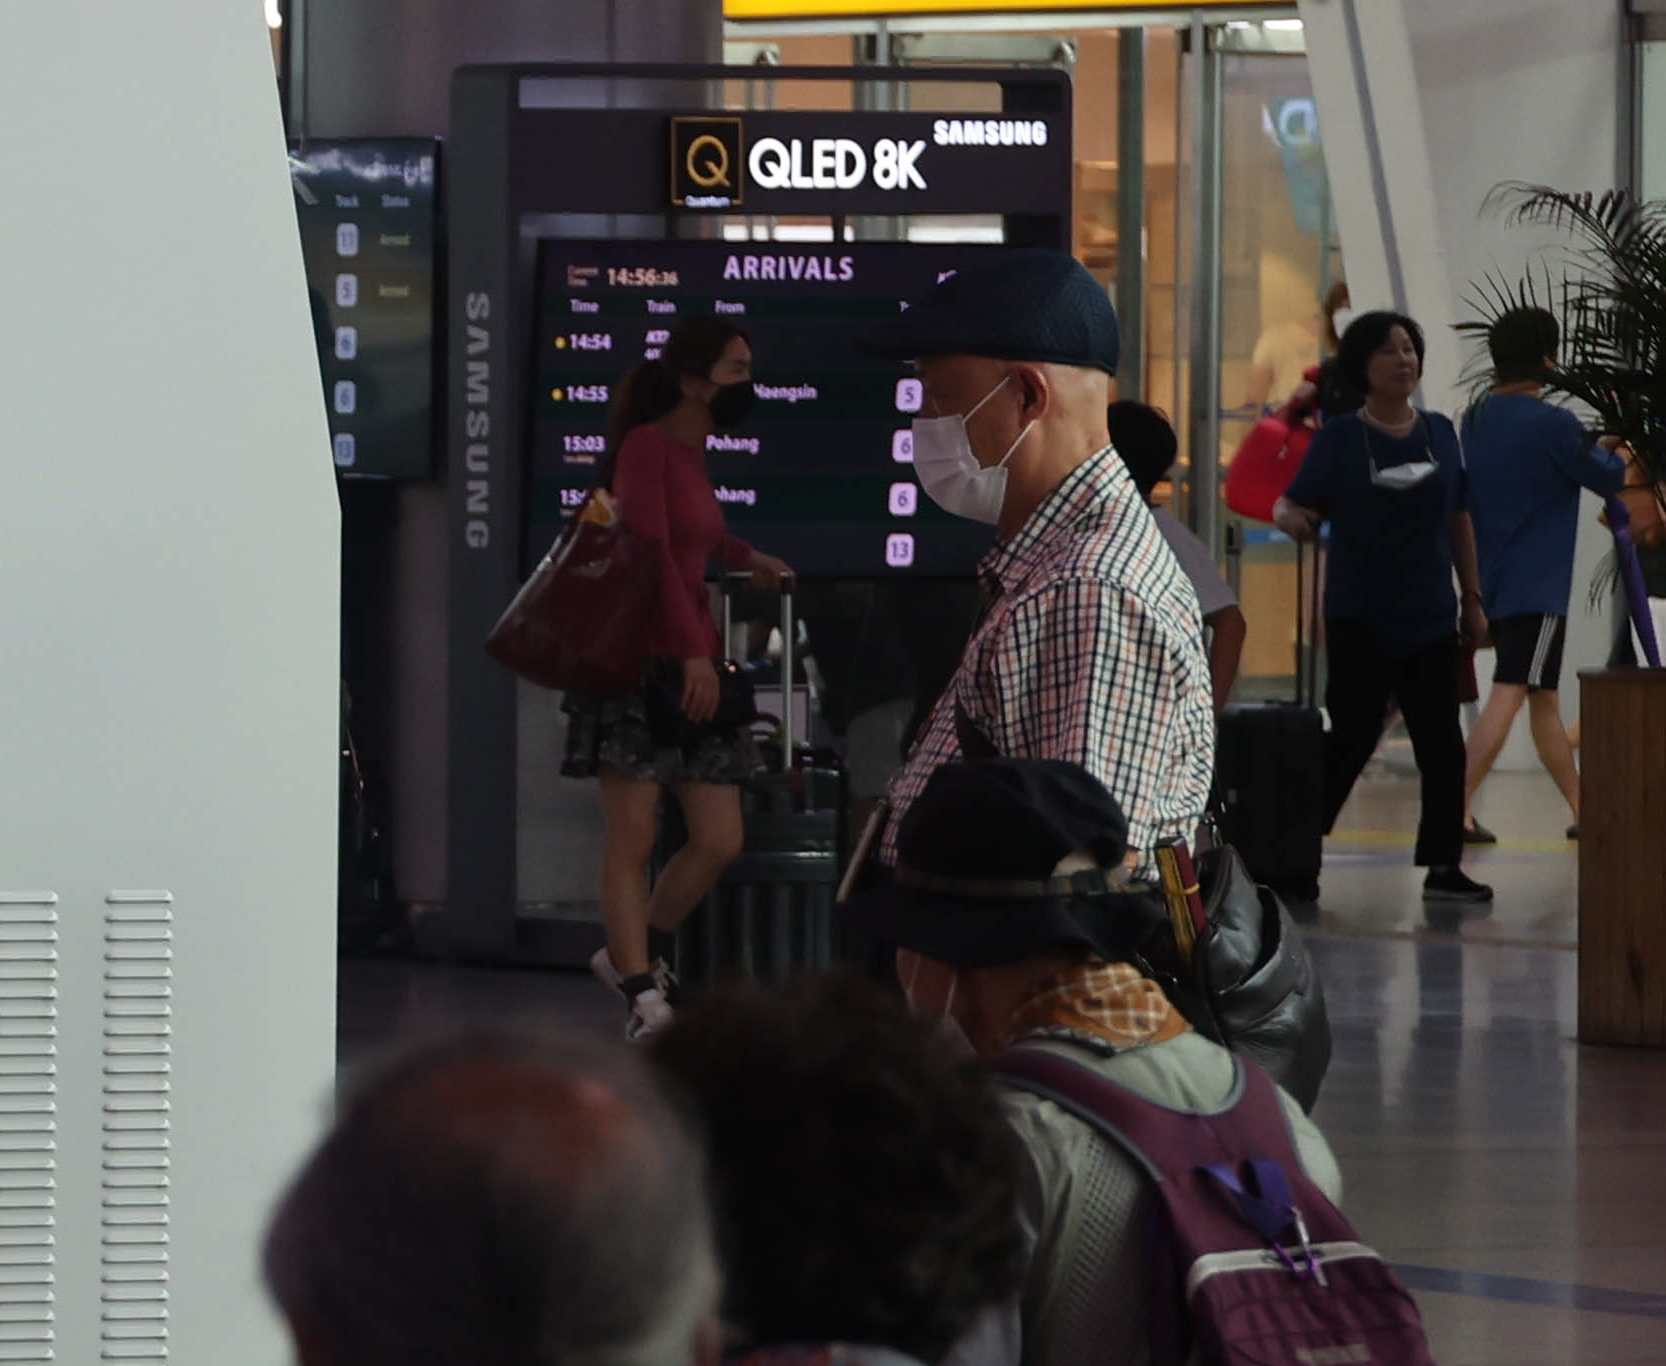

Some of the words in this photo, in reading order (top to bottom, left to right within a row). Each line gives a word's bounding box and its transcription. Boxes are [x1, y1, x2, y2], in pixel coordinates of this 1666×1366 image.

[933, 120, 1048, 146] SAMSUNG
[685, 134, 731, 188] Q
[748, 137, 867, 190] QLED
[873, 137, 928, 190] 8K
[723, 255, 855, 282] ARRIVALS
[570, 299, 599, 313] Time
[645, 299, 677, 313] Train
[715, 299, 745, 314] From
[570, 333, 612, 350] 14:54
[567, 385, 609, 402] 14:55
[465, 292, 490, 549] SAMSUNG
[563, 435, 606, 453] 15:03
[706, 434, 761, 456] Pohang
